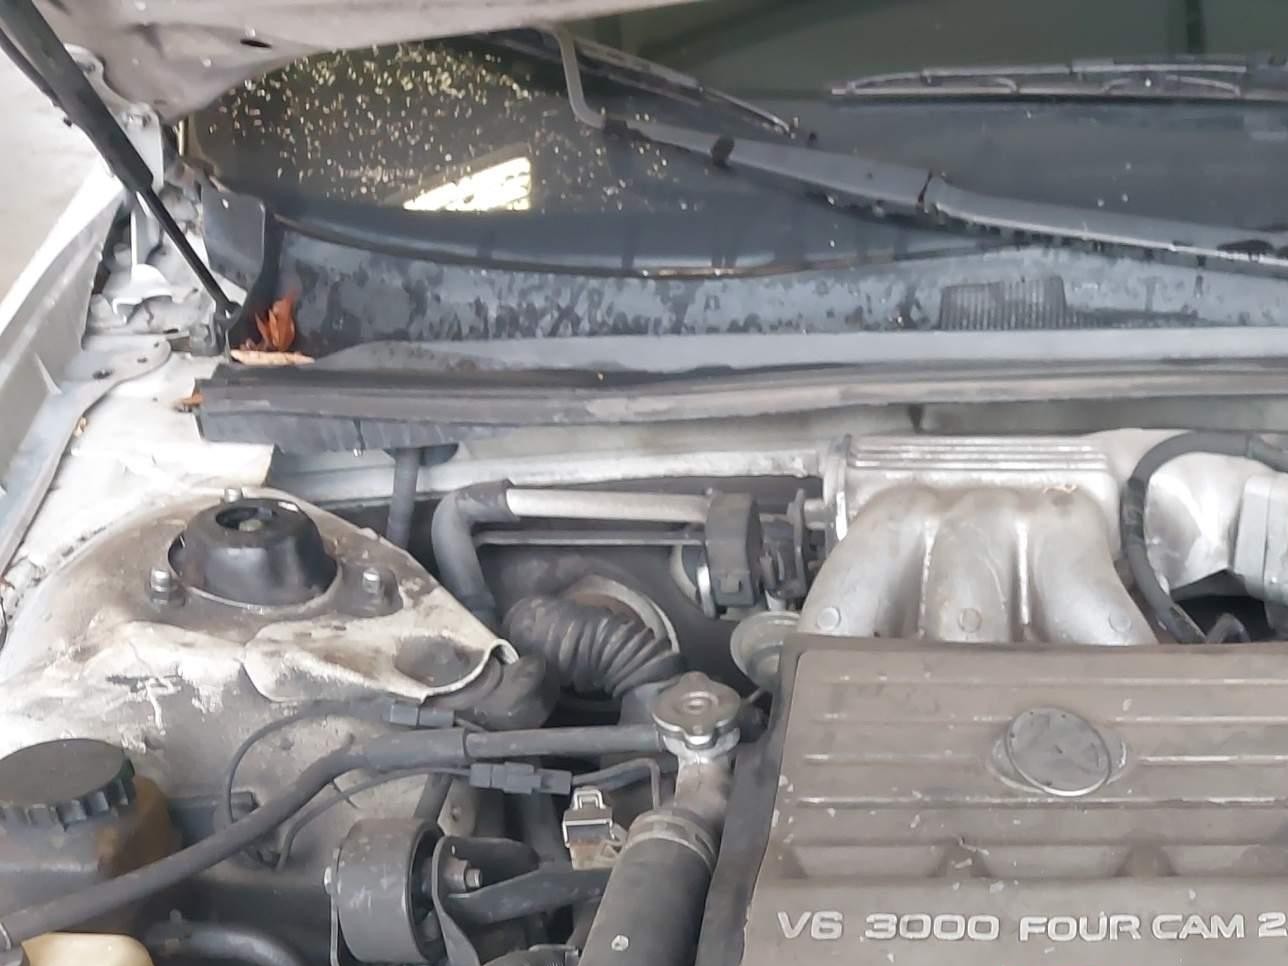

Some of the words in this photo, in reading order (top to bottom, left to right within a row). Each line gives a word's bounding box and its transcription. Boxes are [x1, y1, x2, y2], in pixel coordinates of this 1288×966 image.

[776, 911, 844, 940] V6
[864, 912, 1000, 941] 3000
[1018, 912, 1142, 941] FOUR
[1152, 912, 1246, 940] CAM
